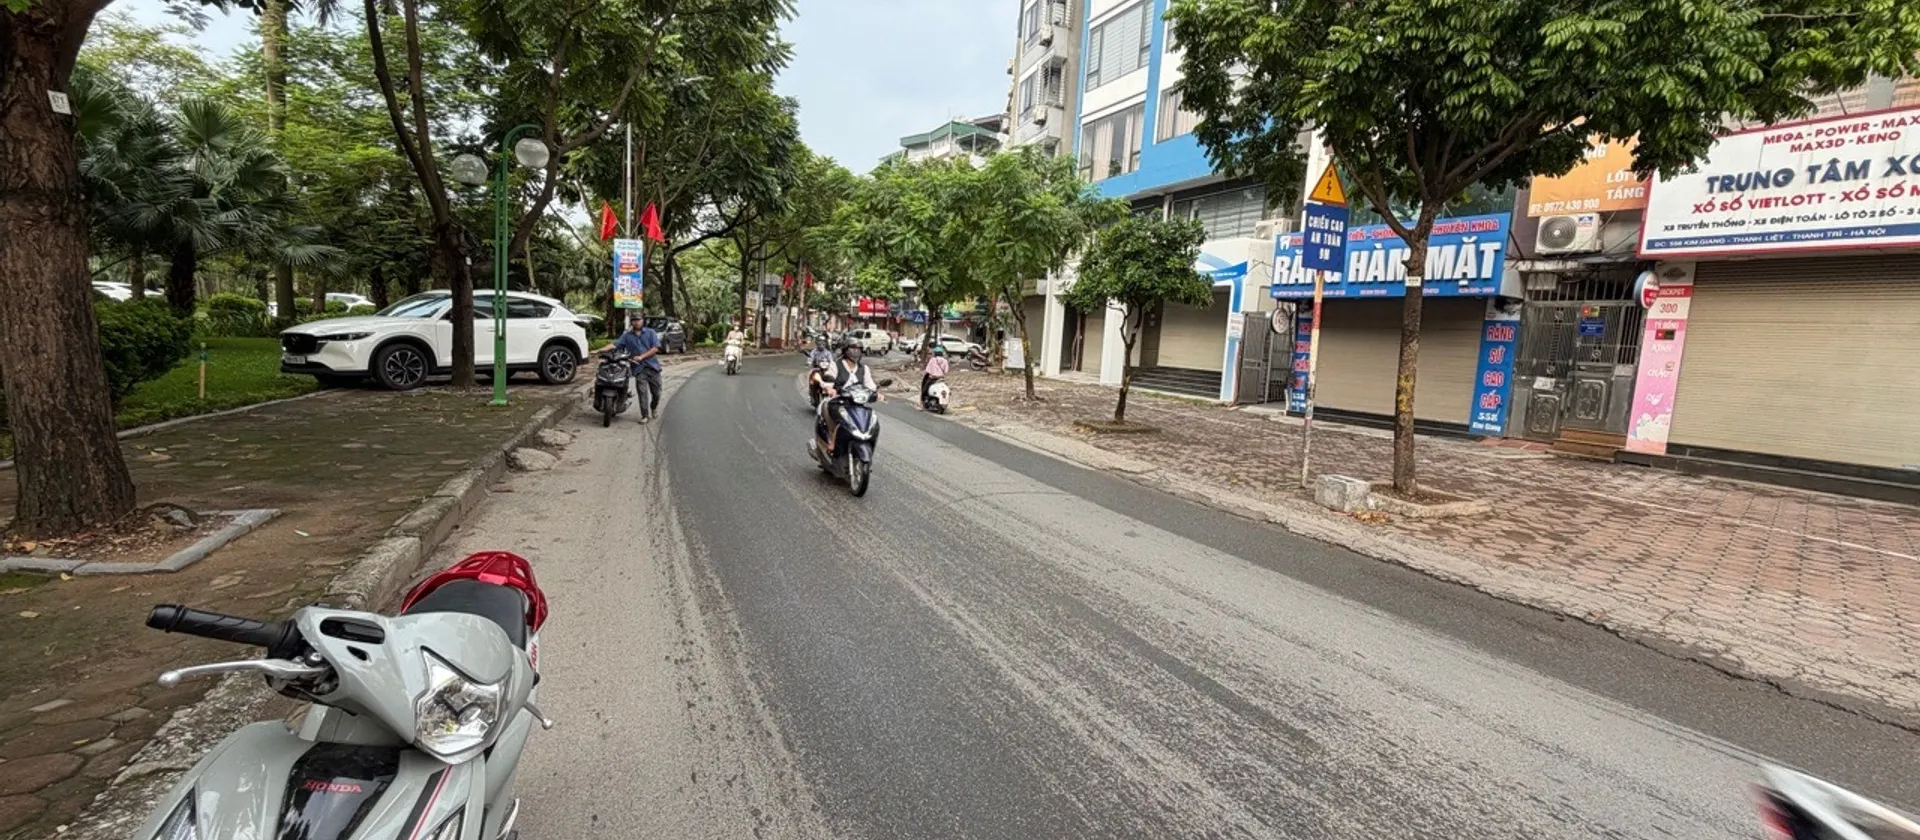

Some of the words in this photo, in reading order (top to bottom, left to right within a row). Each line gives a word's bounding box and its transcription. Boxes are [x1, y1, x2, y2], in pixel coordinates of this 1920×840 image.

[1763, 131, 1804, 145] MEGA
[1814, 122, 1870, 138] POWER
[1790, 138, 1845, 153] MAX3D
[1856, 131, 1902, 145] KENO
[1706, 168, 1795, 195] TRUNG
[1806, 157, 1872, 184] TÂM
[1692, 197, 1716, 214] XỔ
[1719, 194, 1744, 212] SỐ
[1747, 193, 1826, 210] VIETLOTT
[1839, 182, 1871, 203] XỔ
[1875, 180, 1907, 200] SỐ
[1330, 219, 1344, 233] CAO
[1711, 218, 1745, 229] THỐNG
[1796, 212, 1826, 223] TOÁN
[1835, 211, 1850, 220] LÔ
[1878, 205, 1897, 217] SỐ
[1792, 232, 1824, 240] THANH
[1850, 228, 1865, 236] HÀ
[1867, 227, 1887, 235] NỘI
[1424, 235, 1502, 286] MẶT
[1486, 323, 1516, 342] RĂNG
[1483, 370, 1505, 387] CAO
[303, 781, 362, 793] HONDA
